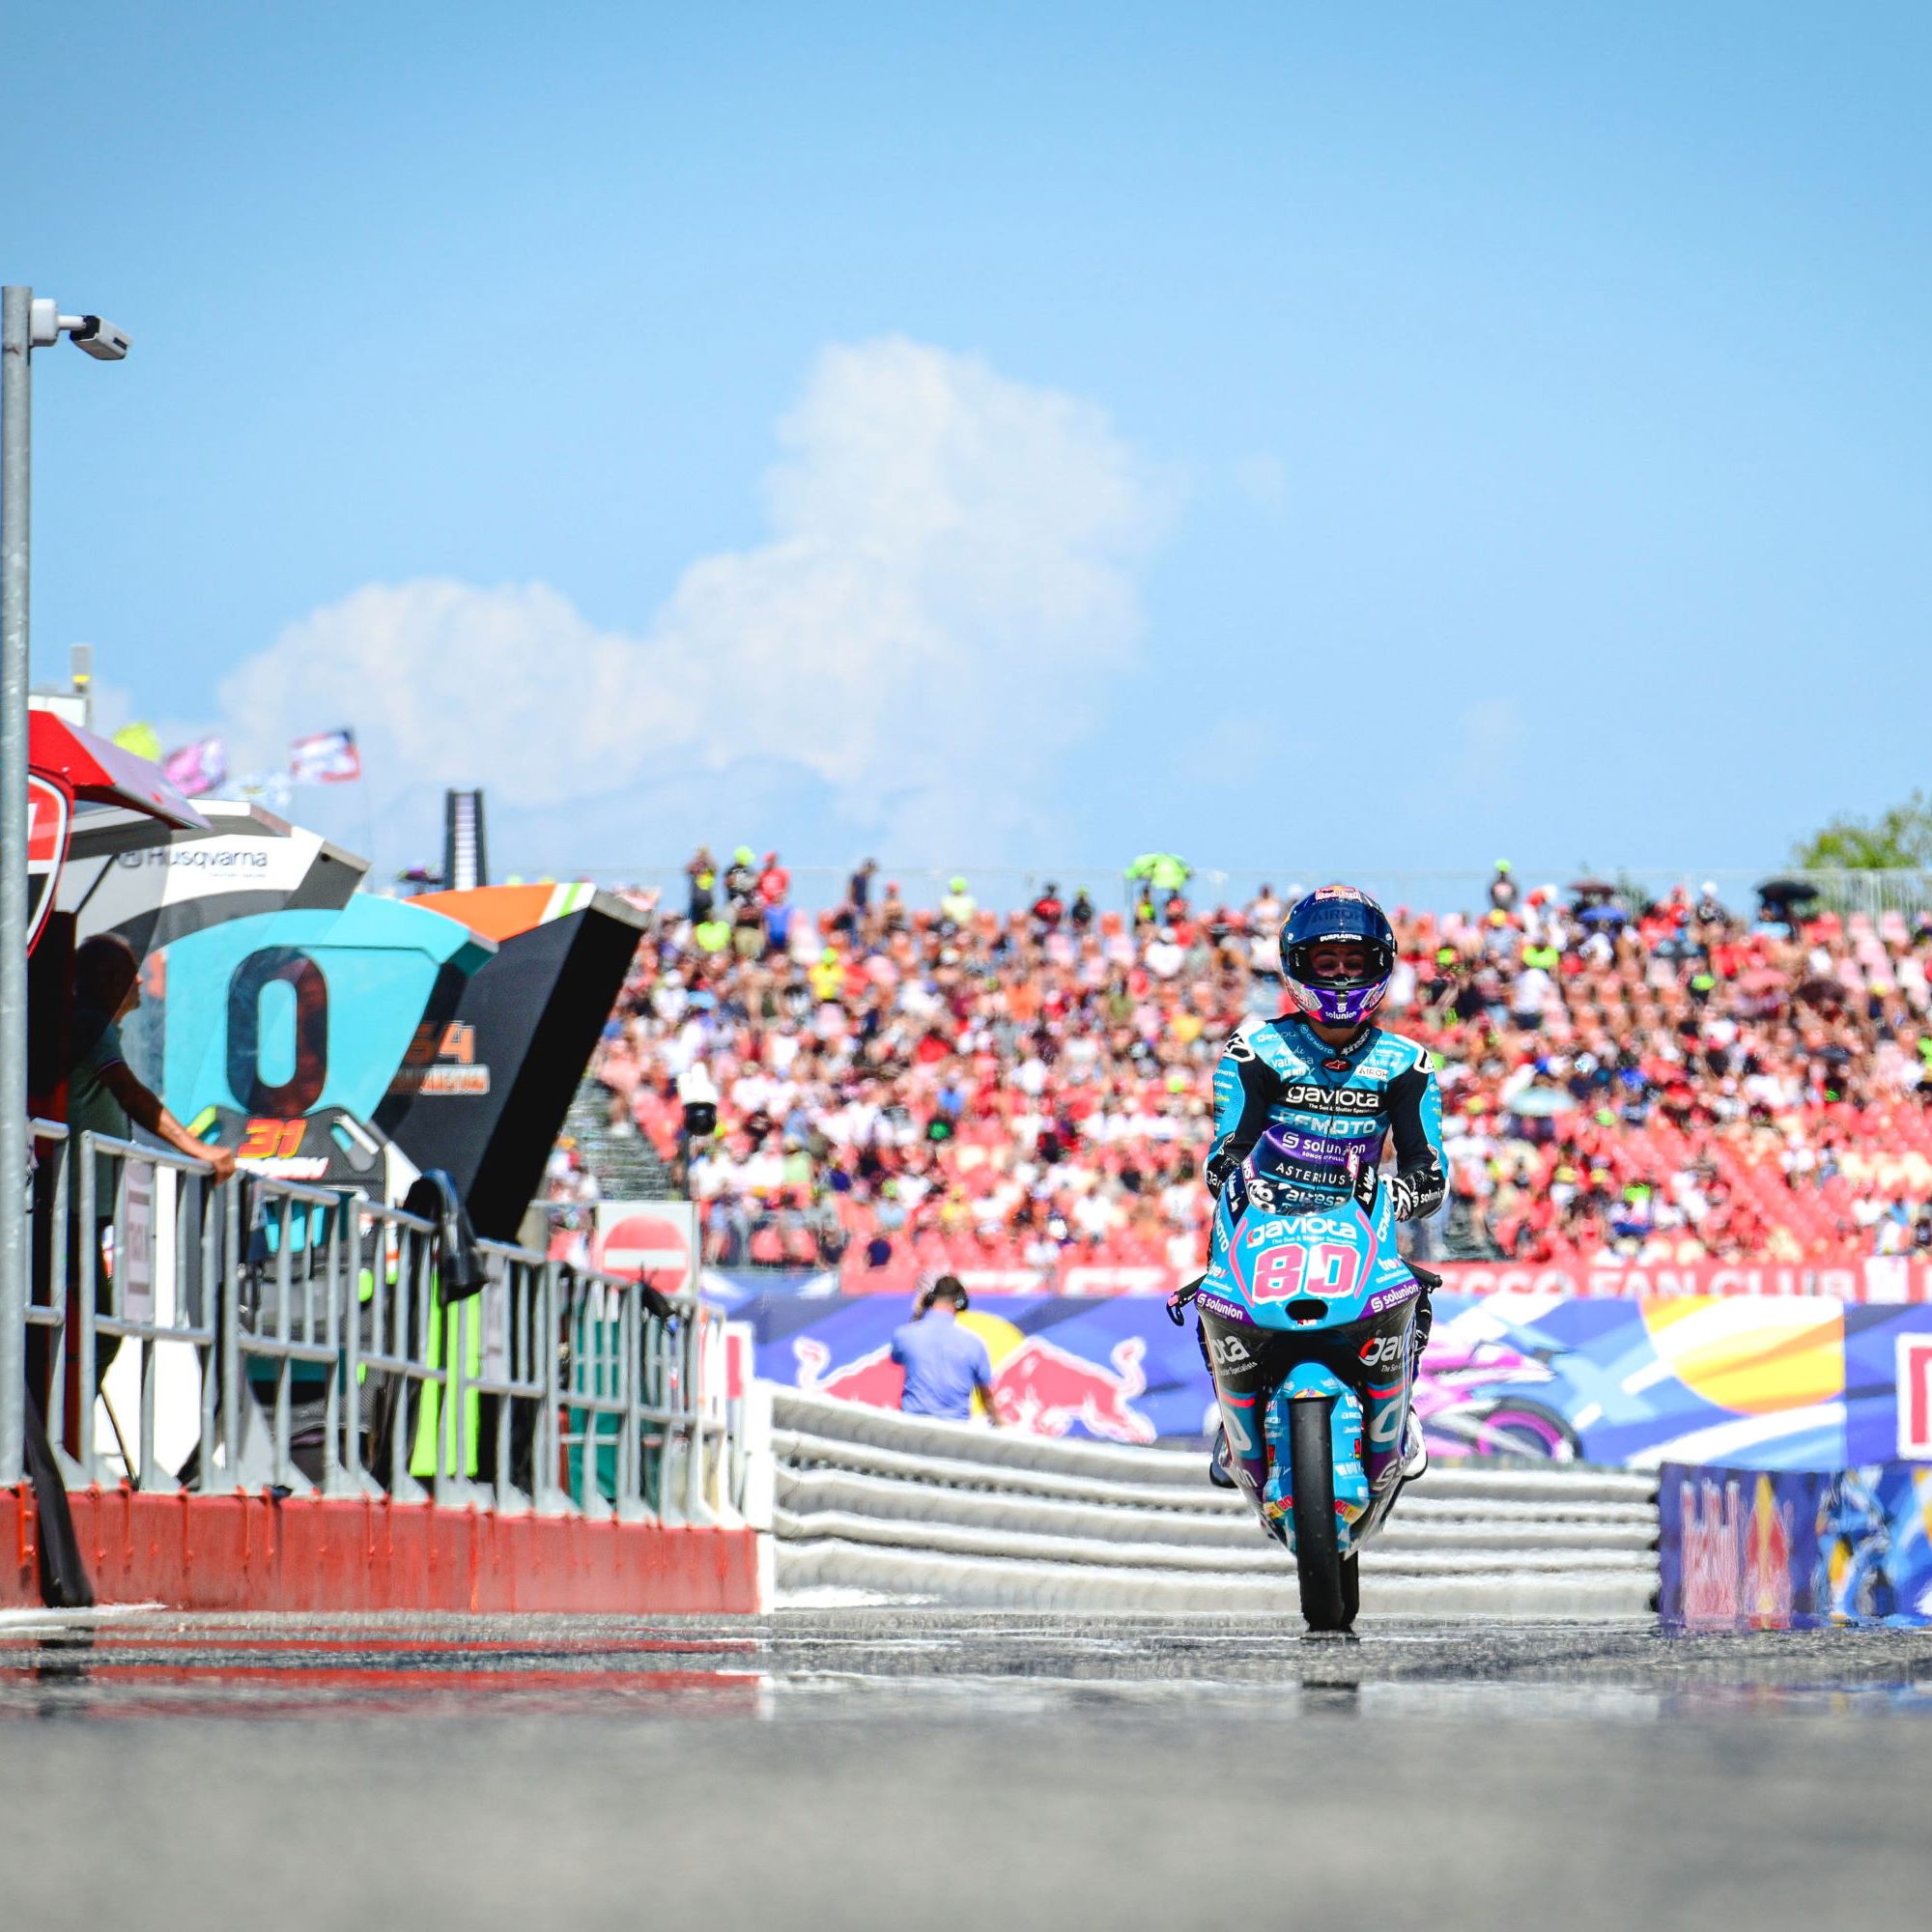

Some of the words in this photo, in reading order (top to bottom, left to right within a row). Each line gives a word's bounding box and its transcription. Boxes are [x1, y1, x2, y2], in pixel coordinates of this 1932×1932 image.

[148, 846, 268, 868] Husqvarna
[1325, 1010, 1356, 1019] solunion
[1271, 1056, 1314, 1067] valsa
[1358, 1067, 1388, 1078] AIROH
[1286, 1086, 1379, 1108] gaviota
[1279, 1110, 1377, 1135] CFMOTO
[237, 1118, 309, 1159] 31
[1303, 1139, 1366, 1155] solunion
[1275, 1162, 1346, 1185] ASTERIUS
[1247, 1216, 1358, 1248] gaviota
[1252, 1242, 1361, 1305] 80
[1589, 1268, 1697, 1298] FAN
[1710, 1267, 1857, 1300] CLUB
[1382, 1284, 1419, 1305] solunion
[1206, 1297, 1243, 1321] solunion
